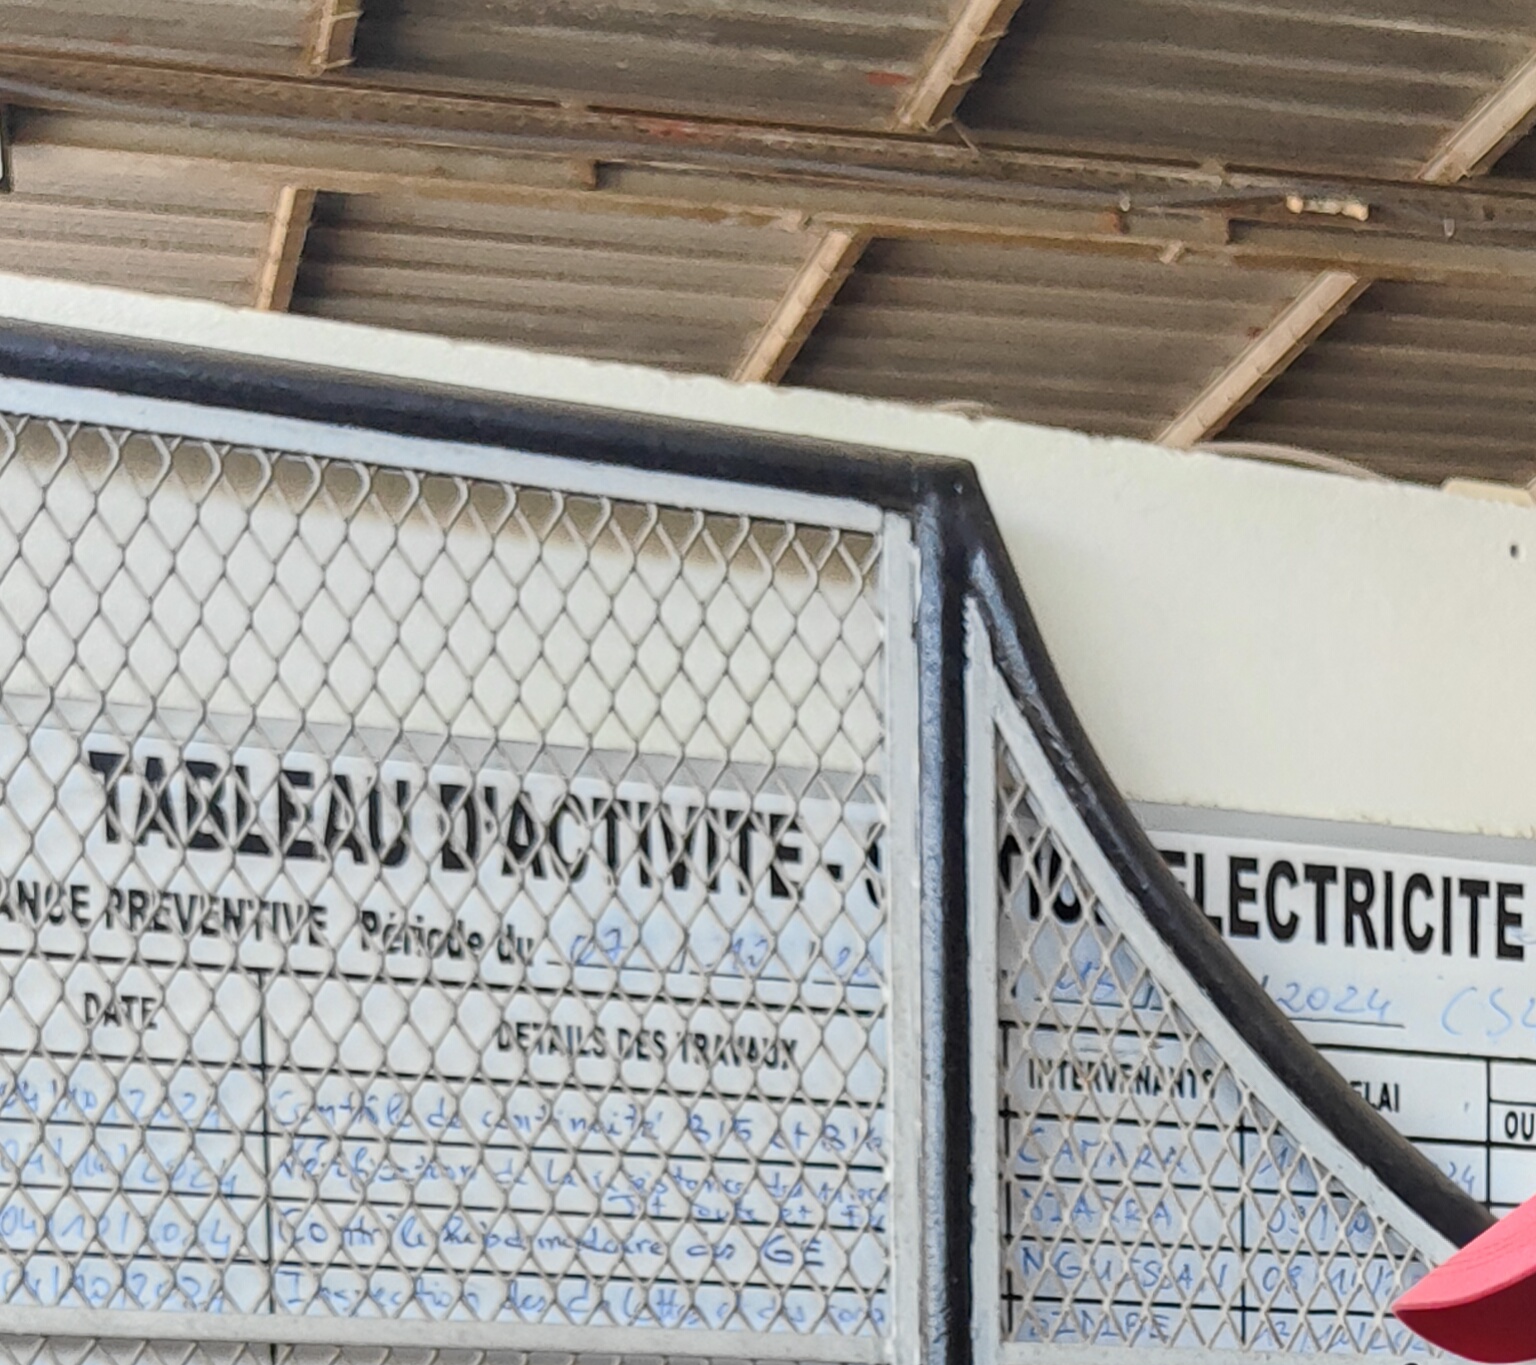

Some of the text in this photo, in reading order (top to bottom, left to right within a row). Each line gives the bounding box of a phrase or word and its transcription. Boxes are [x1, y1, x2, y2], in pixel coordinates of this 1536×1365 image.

[89, 751, 410, 868] TABLEAU
[439, 783, 804, 900] D'ACTIVITE
[106, 887, 328, 947] PREVENTIVE
[84, 992, 158, 1030] DATE
[1277, 981, 1391, 1022] 2024
[617, 1026, 668, 1062] DES
